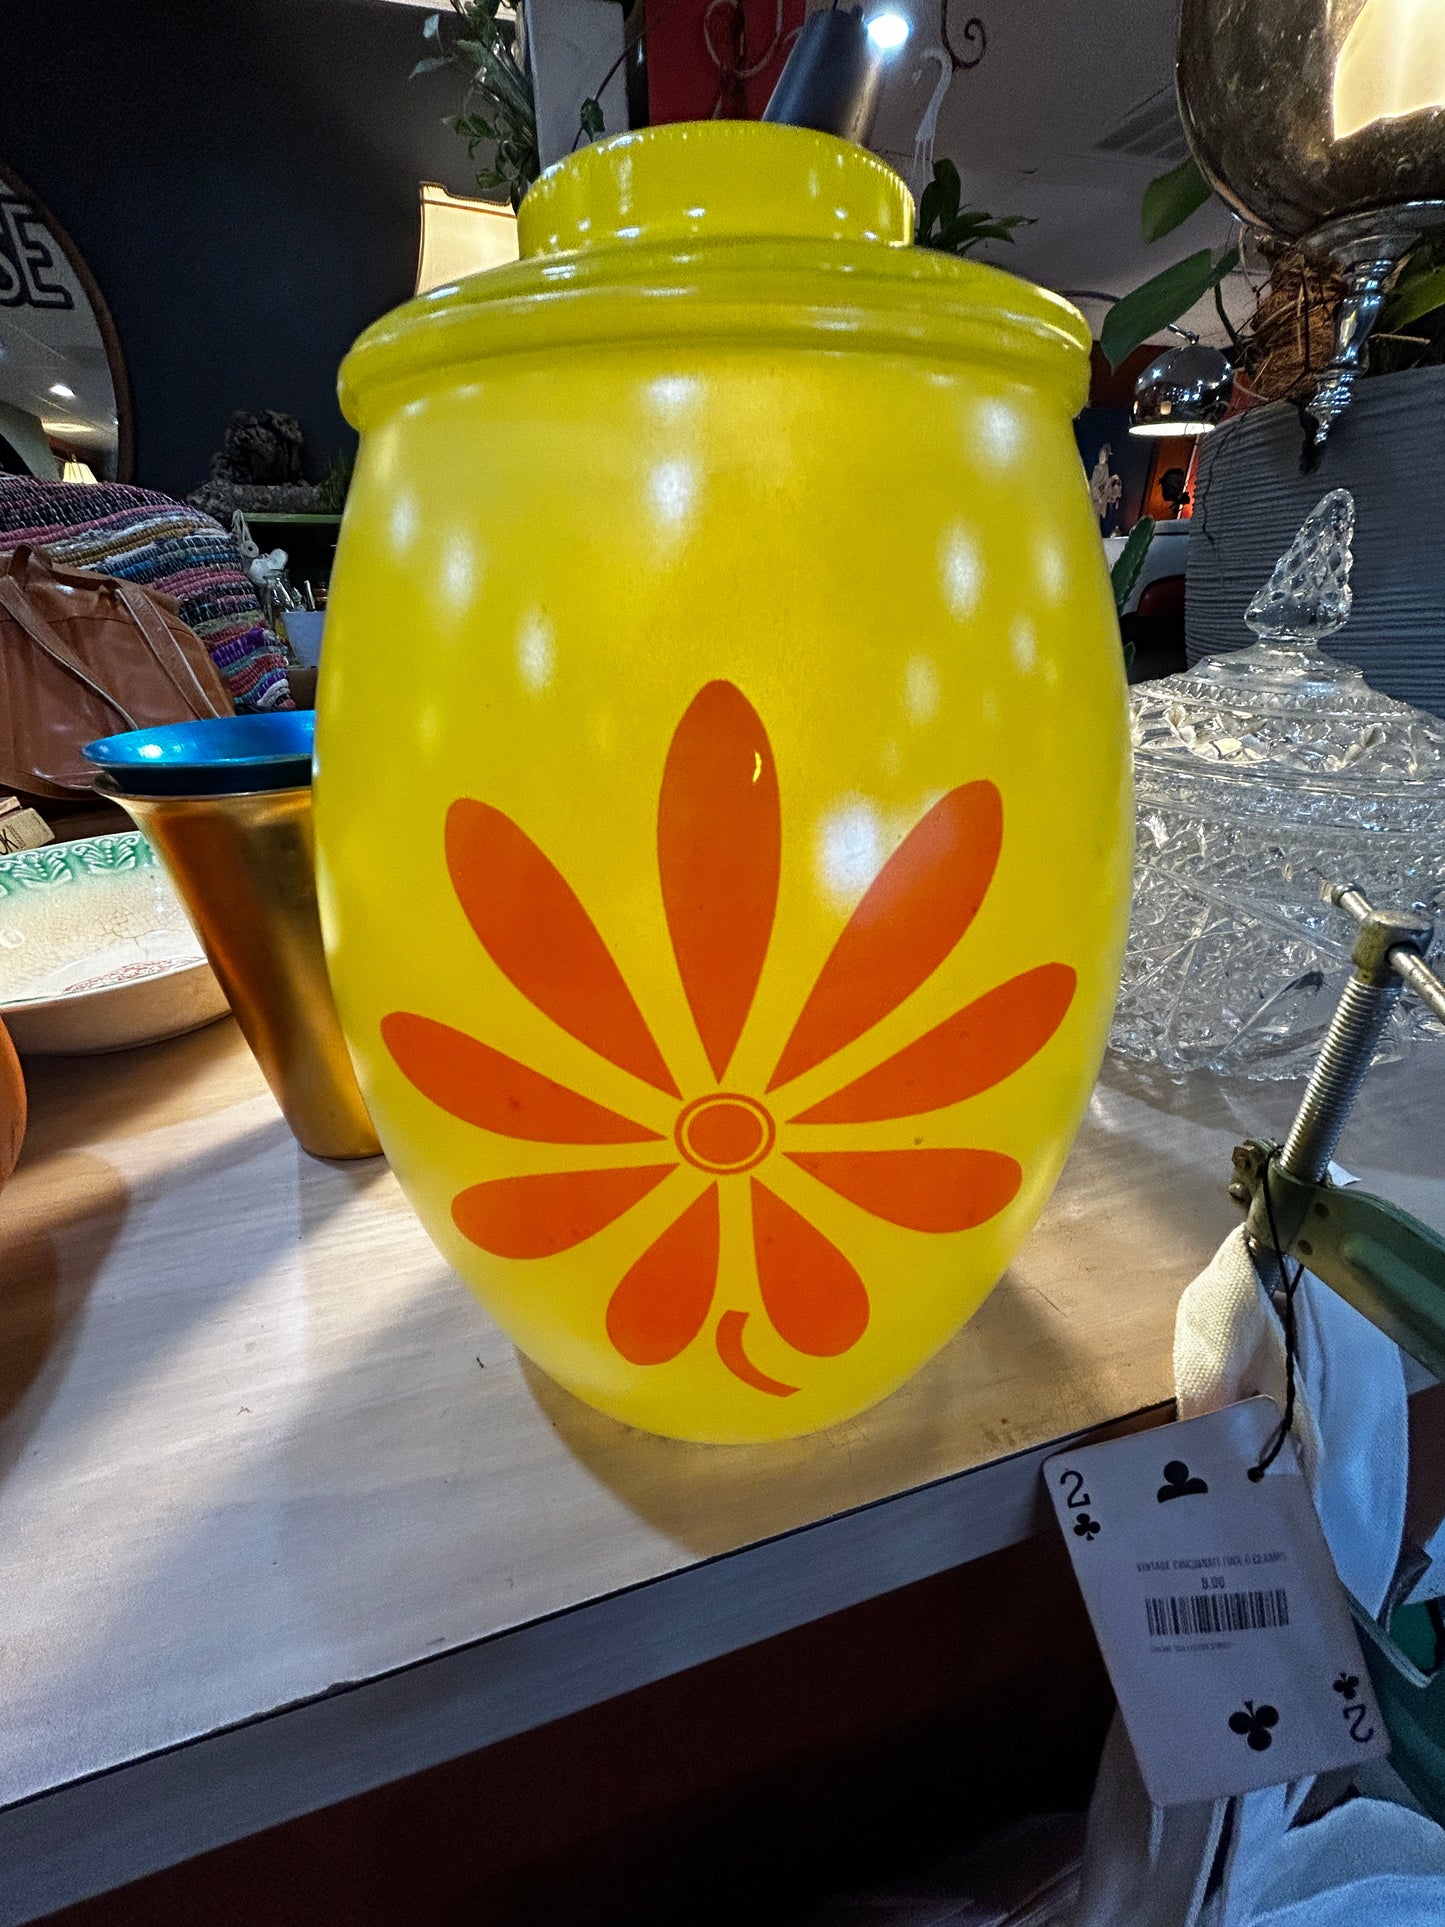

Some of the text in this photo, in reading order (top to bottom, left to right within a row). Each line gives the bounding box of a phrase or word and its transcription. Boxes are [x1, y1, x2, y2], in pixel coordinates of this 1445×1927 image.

[1060, 1470, 1091, 1508] 2
[1136, 1560, 1170, 1572] VINTAGE
[1343, 1704, 1374, 1743] 2
